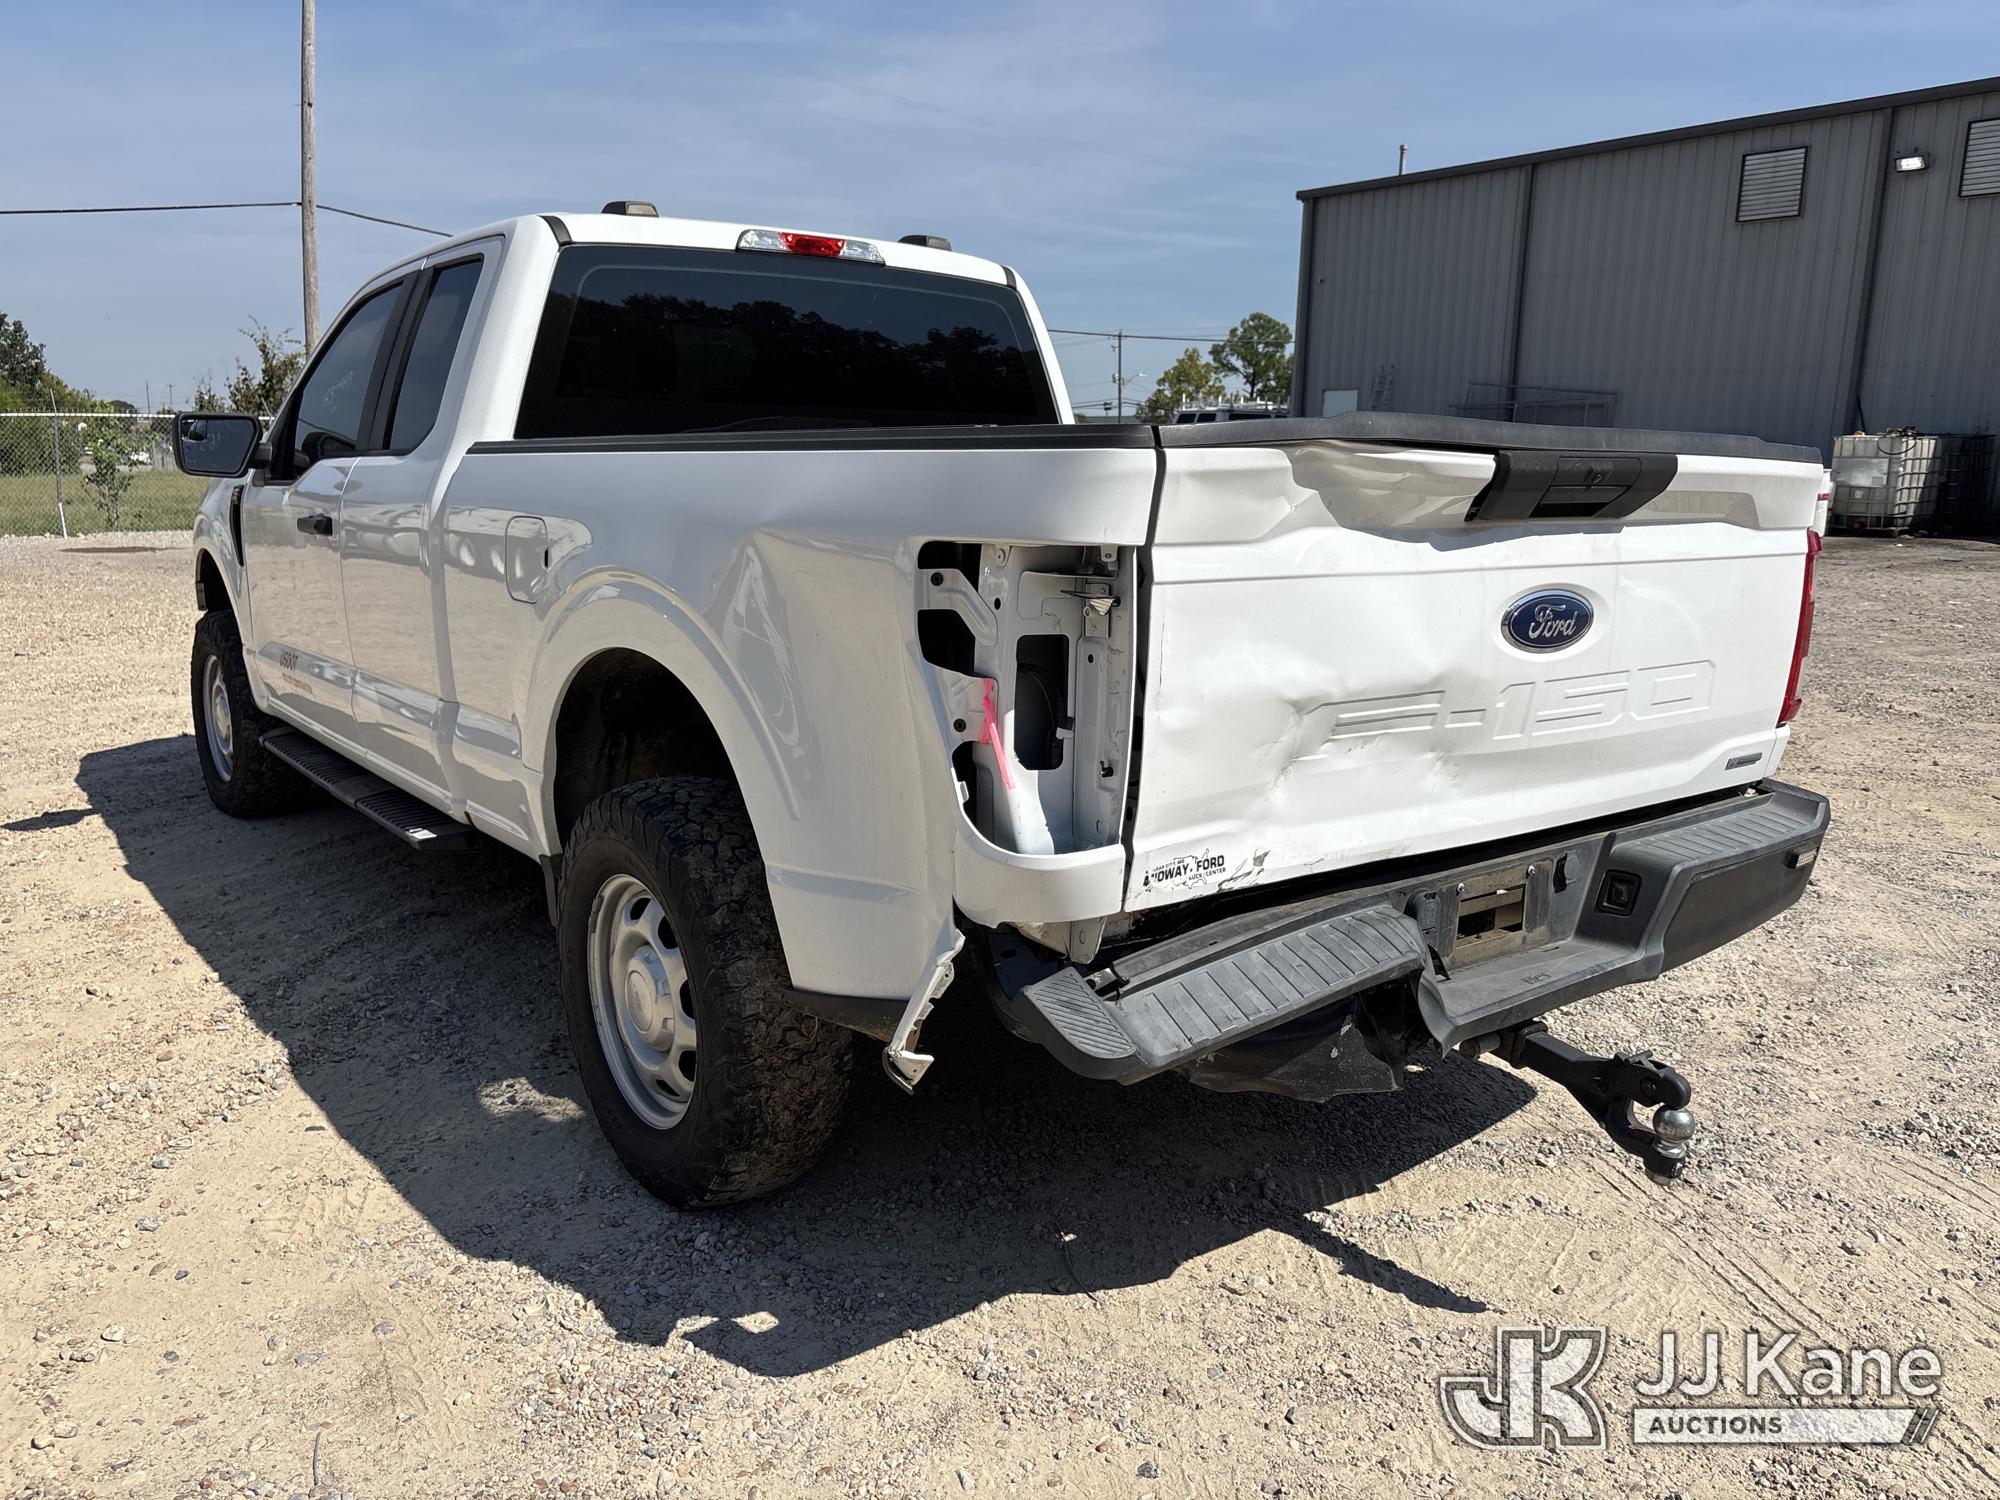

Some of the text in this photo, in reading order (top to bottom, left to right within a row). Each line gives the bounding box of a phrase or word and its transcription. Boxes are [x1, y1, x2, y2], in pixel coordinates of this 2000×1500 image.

[1528, 603, 1579, 639] Ford
[1294, 659, 1717, 760] F-150
[1196, 854, 1225, 873] FORD
[1205, 867, 1227, 877] CENTER
